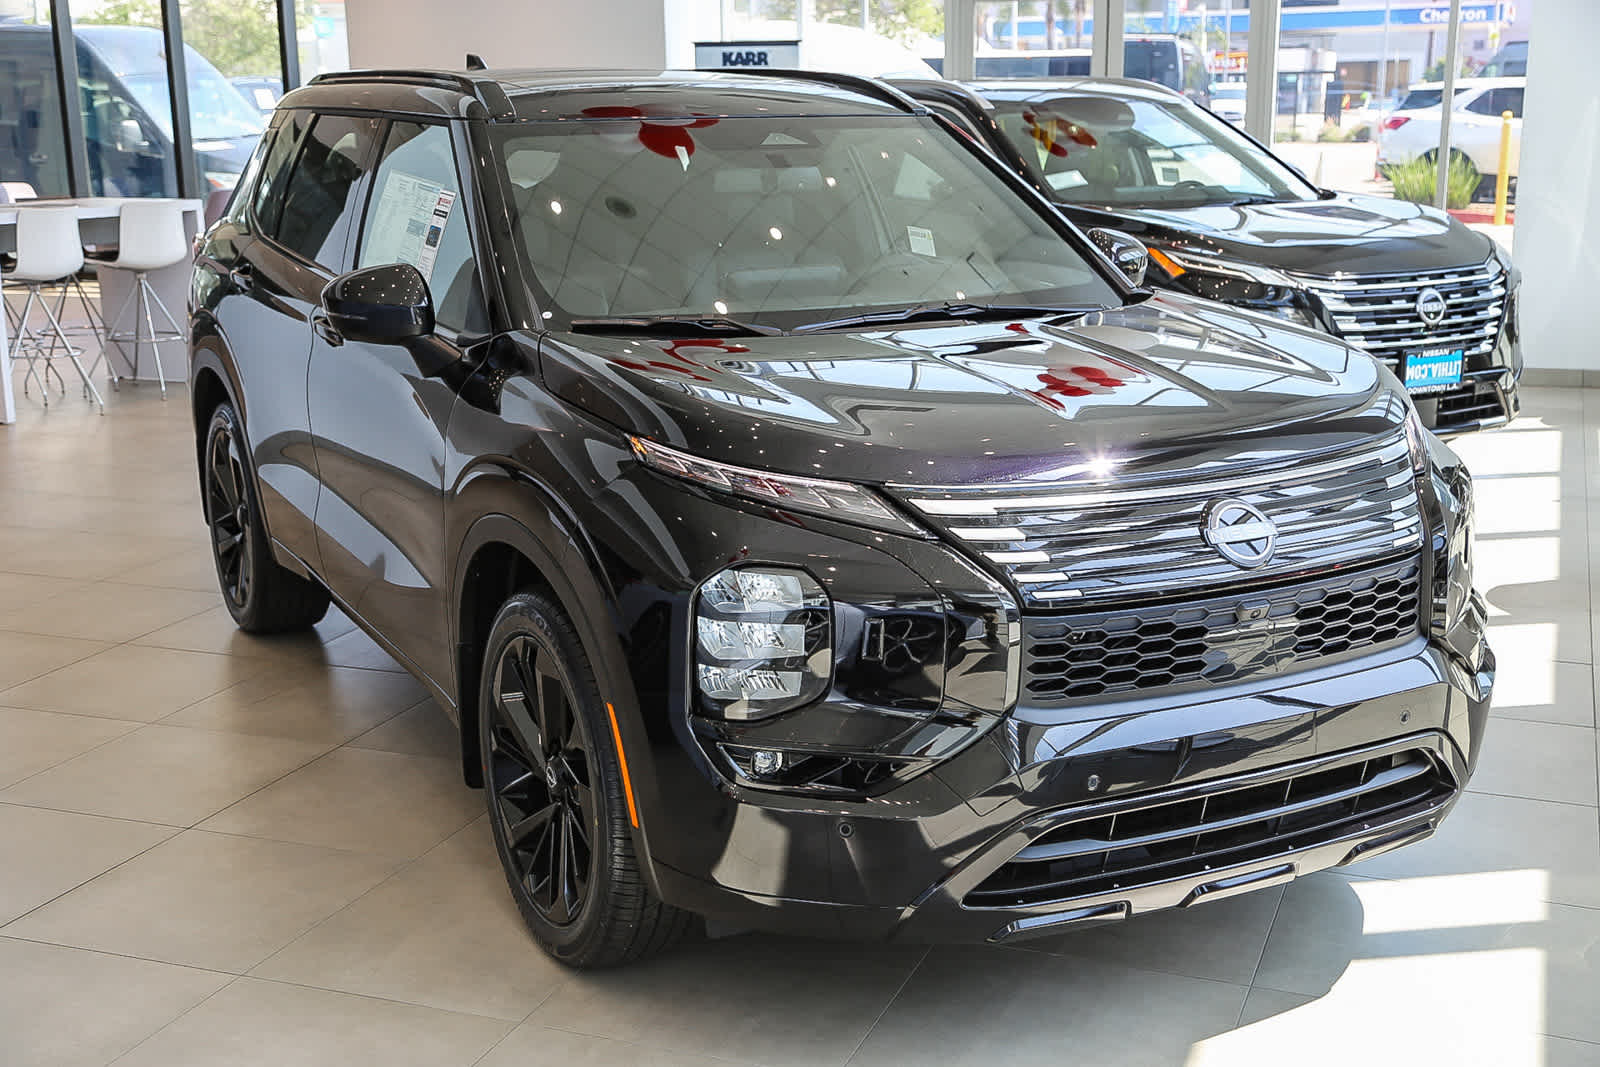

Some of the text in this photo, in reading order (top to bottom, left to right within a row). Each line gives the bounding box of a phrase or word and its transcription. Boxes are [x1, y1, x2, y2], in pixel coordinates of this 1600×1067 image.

[1420, 8, 1488, 23] Cheron
[722, 51, 768, 66] KARR
[1406, 360, 1462, 381] LITHIA.COM
